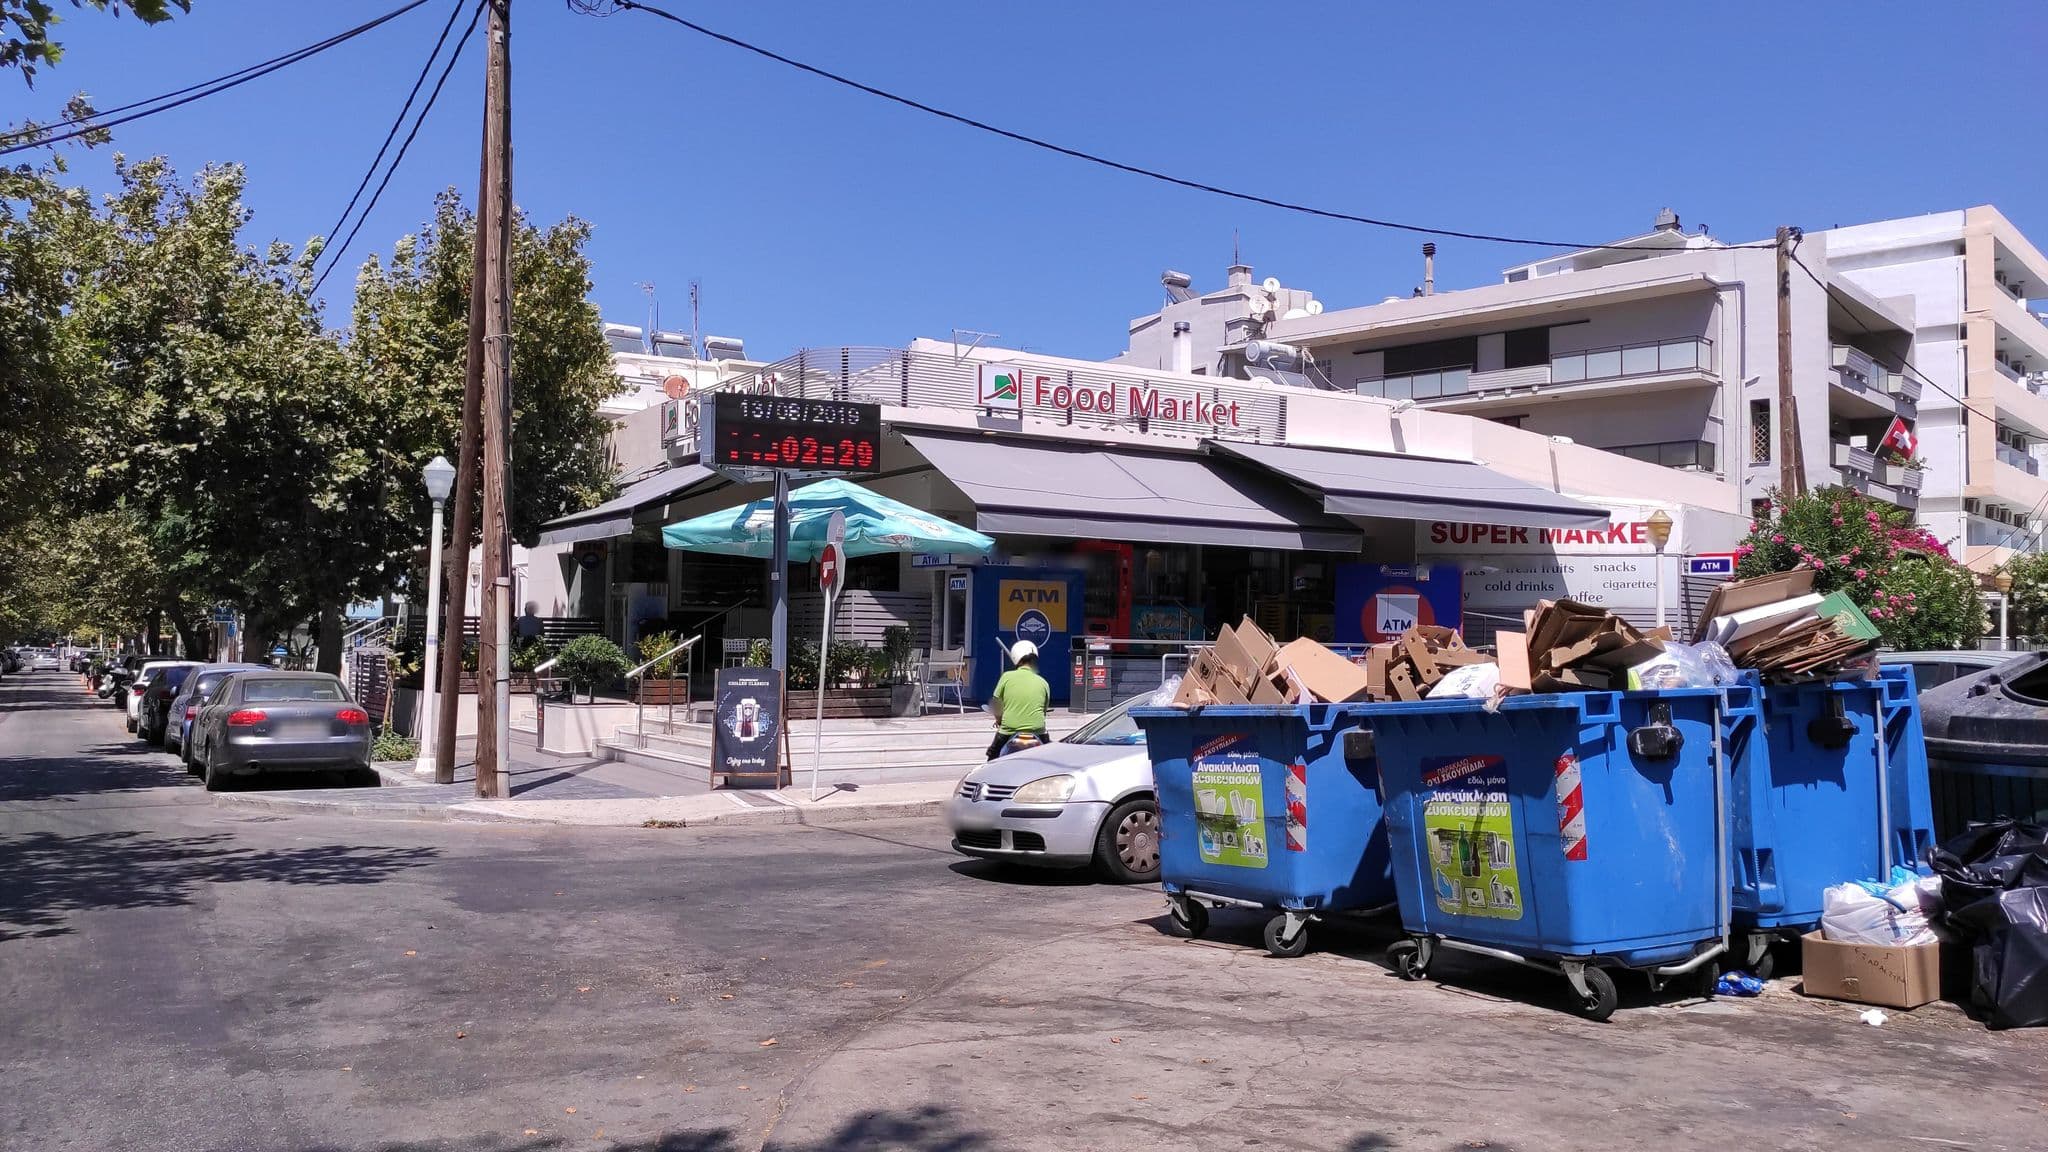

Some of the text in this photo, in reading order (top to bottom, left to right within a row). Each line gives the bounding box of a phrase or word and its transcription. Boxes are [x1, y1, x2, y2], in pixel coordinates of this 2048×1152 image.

[1033, 375, 1241, 427] Food Market
[1430, 521, 1649, 545] SUPER MARKE
[922, 556, 940, 565] ATM
[1701, 562, 1720, 570] ATM
[1593, 561, 1637, 573] snacks
[951, 579, 966, 589] ATM
[1485, 581, 1511, 592] cold
[1515, 581, 1554, 592] drinks
[1009, 588, 1060, 604] ATM
[1382, 619, 1412, 631] ATM
[1243, 750, 1259, 759] μόνο
[1197, 761, 1260, 773] Ανακύκλωση
[1487, 776, 1506, 786] μόνο
